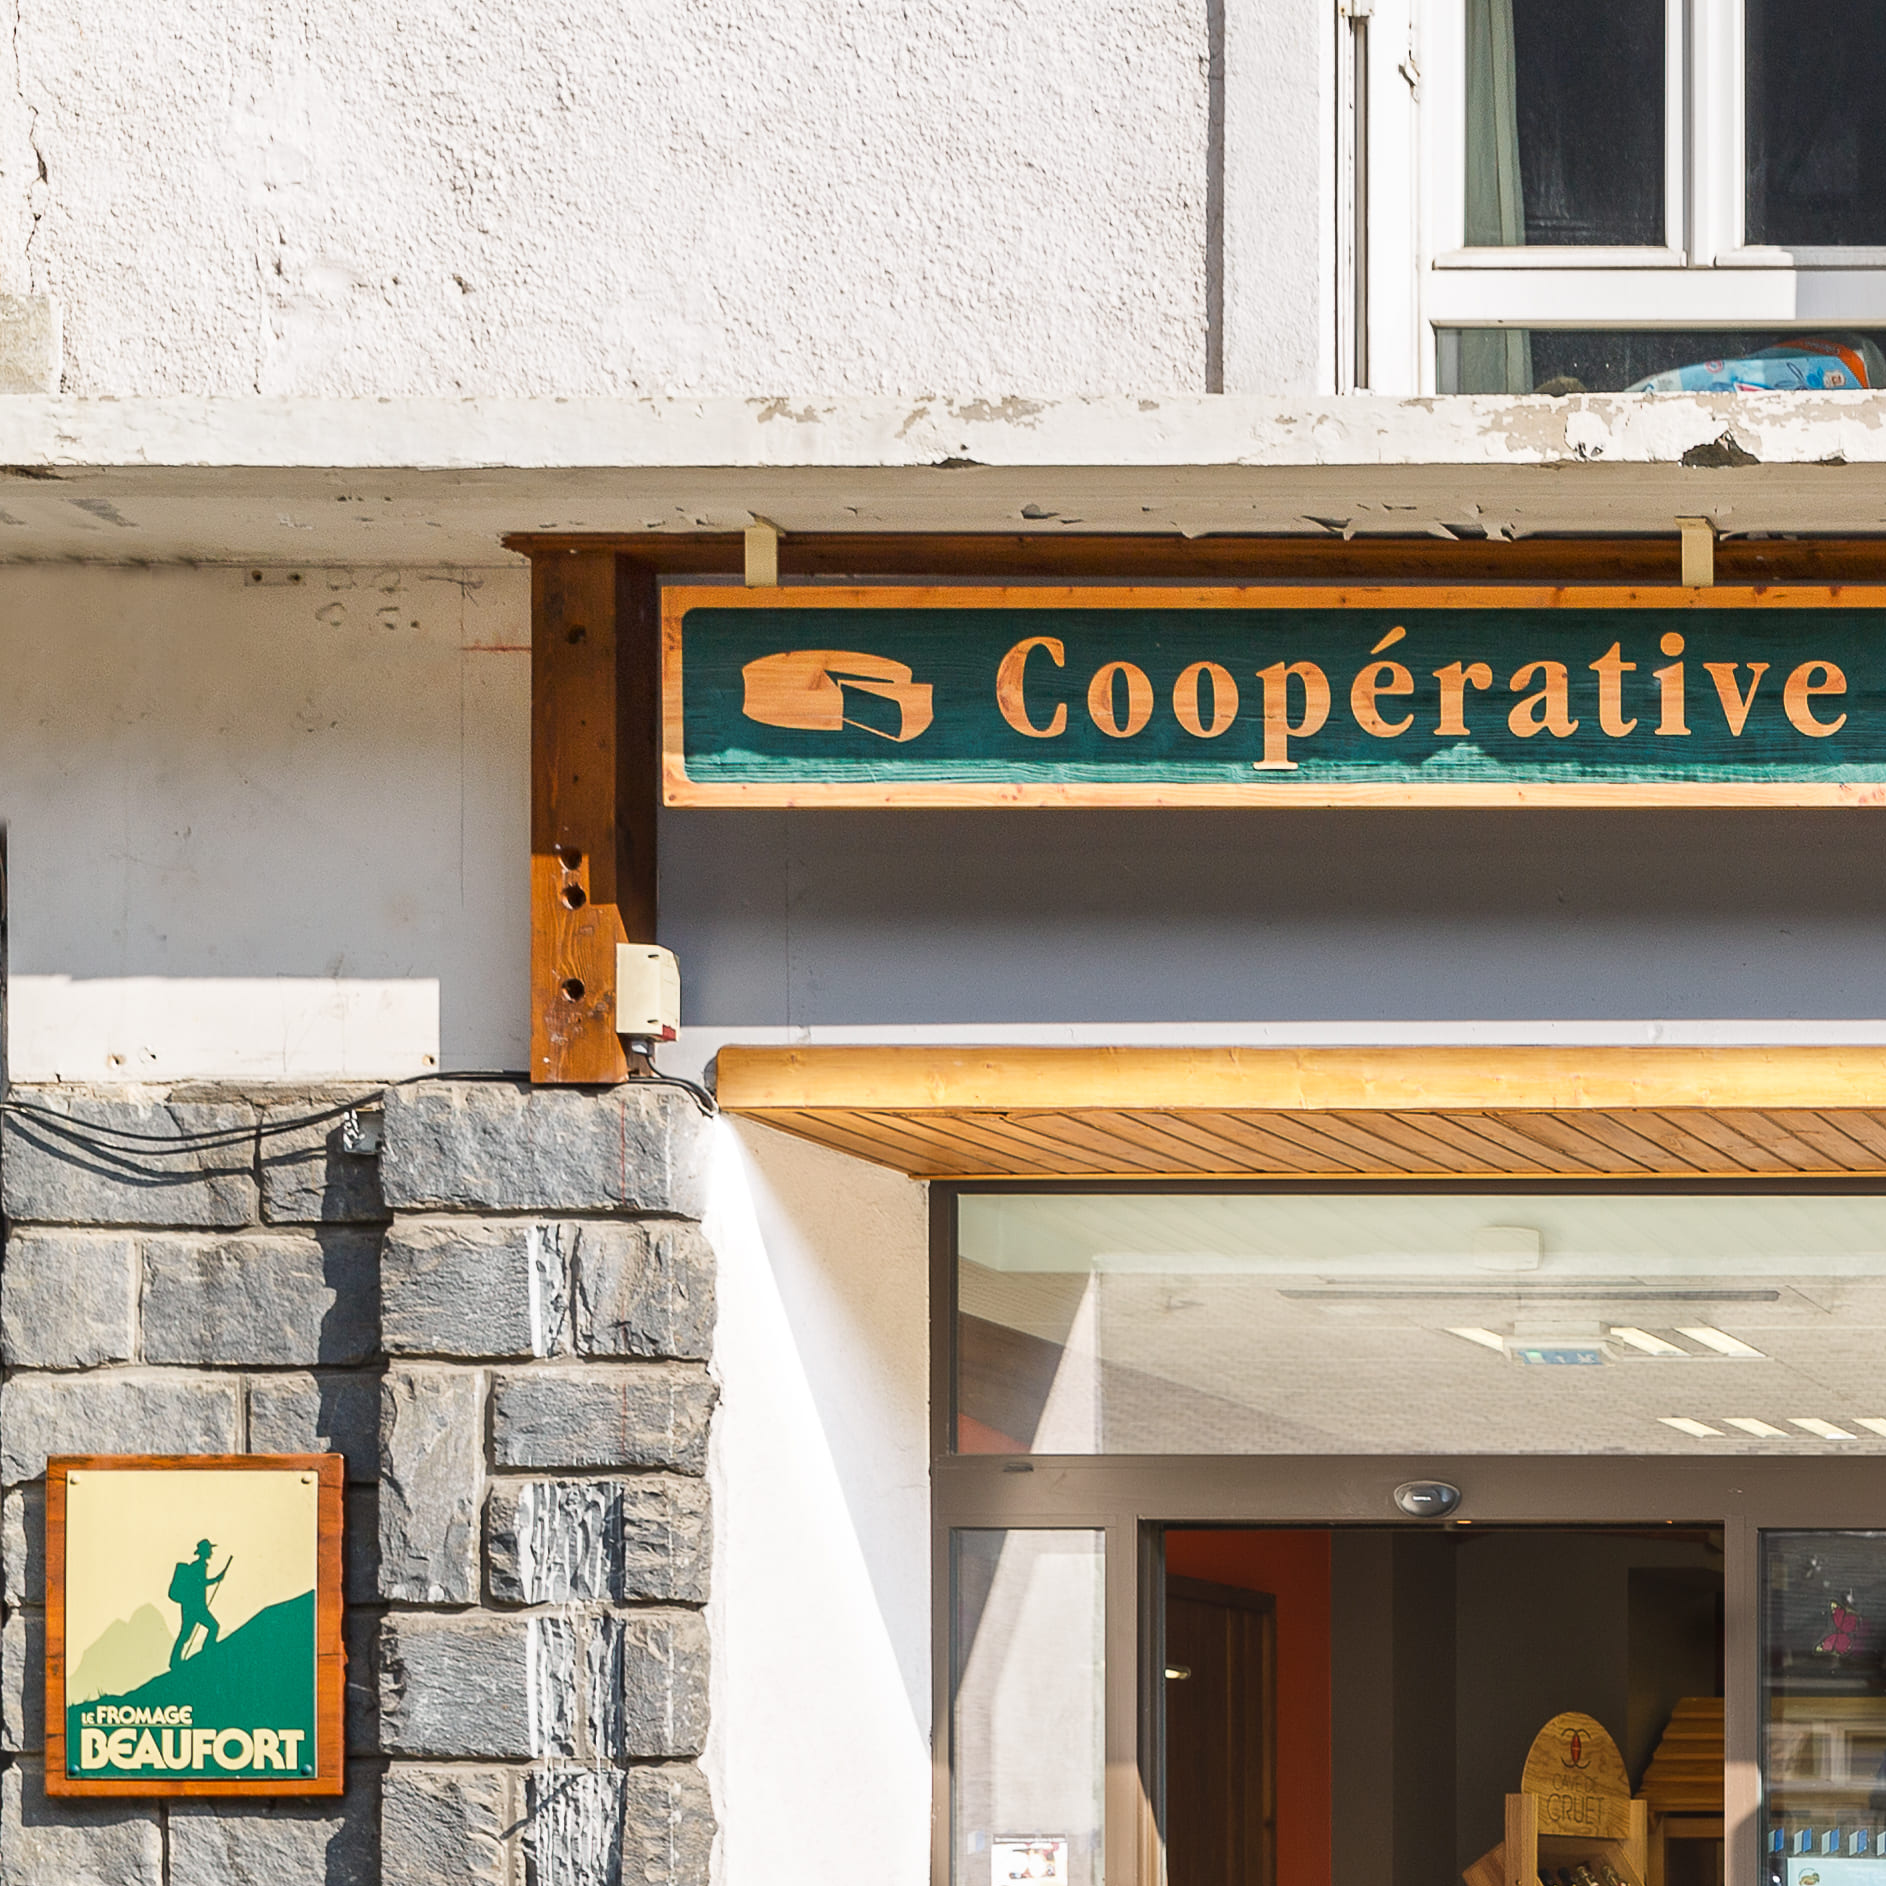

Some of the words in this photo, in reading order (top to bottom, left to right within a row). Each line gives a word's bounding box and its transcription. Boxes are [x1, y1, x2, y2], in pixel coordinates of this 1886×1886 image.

[996, 625, 1849, 771] Coopérative
[81, 1712, 94, 1724] LE
[97, 1706, 192, 1724] FROMAGE
[81, 1728, 304, 1770] BEAUFORT
[1546, 1793, 1604, 1824] CRUET
